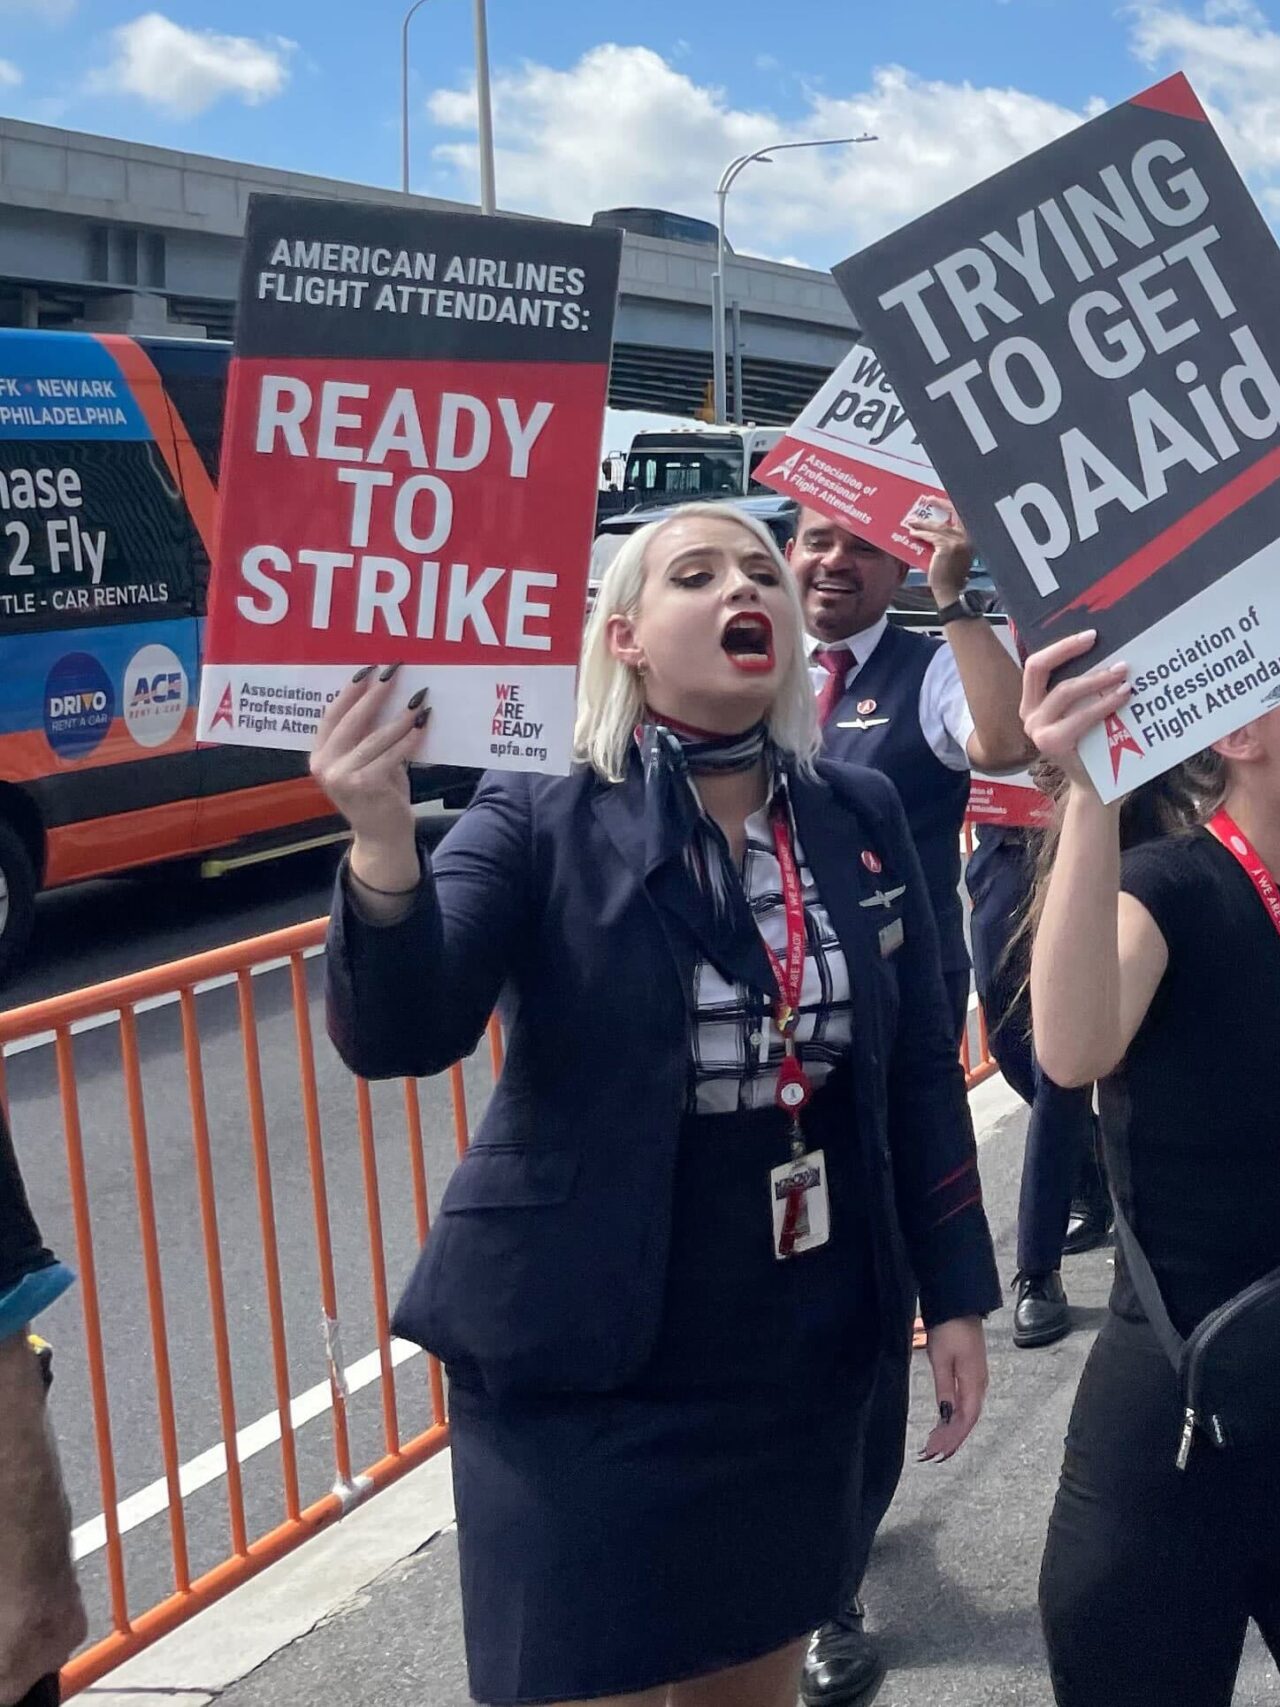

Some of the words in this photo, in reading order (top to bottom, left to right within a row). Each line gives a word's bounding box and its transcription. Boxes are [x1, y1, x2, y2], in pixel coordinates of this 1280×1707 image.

[270, 238, 437, 281] AMERICAN
[443, 255, 586, 296] AIRLINES
[877, 139, 1210, 365] TRYING
[258, 272, 369, 309] FLIGHT
[375, 284, 591, 332] ATTENDANTS:
[925, 336, 1062, 455] TO
[1068, 225, 1238, 380] GET
[0, 379, 21, 397] FK
[36, 379, 116, 398] NEWARK
[1, 406, 127, 425] PHILADELPHIA
[255, 375, 555, 479] READY
[797, 463, 860, 503] Professional
[806, 454, 862, 490] Association
[337, 468, 453, 555] TO
[790, 473, 821, 497] Flight
[819, 489, 873, 526] Attendants
[4, 521, 35, 576] 2
[46, 515, 106, 585] Fly
[0, 593, 36, 614] TLE
[52, 589, 90, 611] CAR
[94, 583, 169, 608] RENTALS
[237, 545, 558, 652] STRIKE
[1239, 605, 1260, 633] of
[130, 672, 182, 707] ACE
[241, 682, 322, 702] Association
[496, 683, 520, 702] WE
[1130, 640, 1255, 724] Professional
[50, 691, 107, 717] DRIVO
[239, 698, 326, 720] Professional
[494, 699, 525, 720] ARE
[52, 719, 77, 732] RENT
[79, 717, 86, 727] A
[88, 714, 108, 726] CAR
[238, 714, 277, 733] Flight
[281, 719, 318, 735] Atten
[491, 719, 543, 739] READY
[1142, 703, 1203, 748] Flight
[490, 741, 547, 761] apfa.org
[1258, 875, 1273, 896] WE
